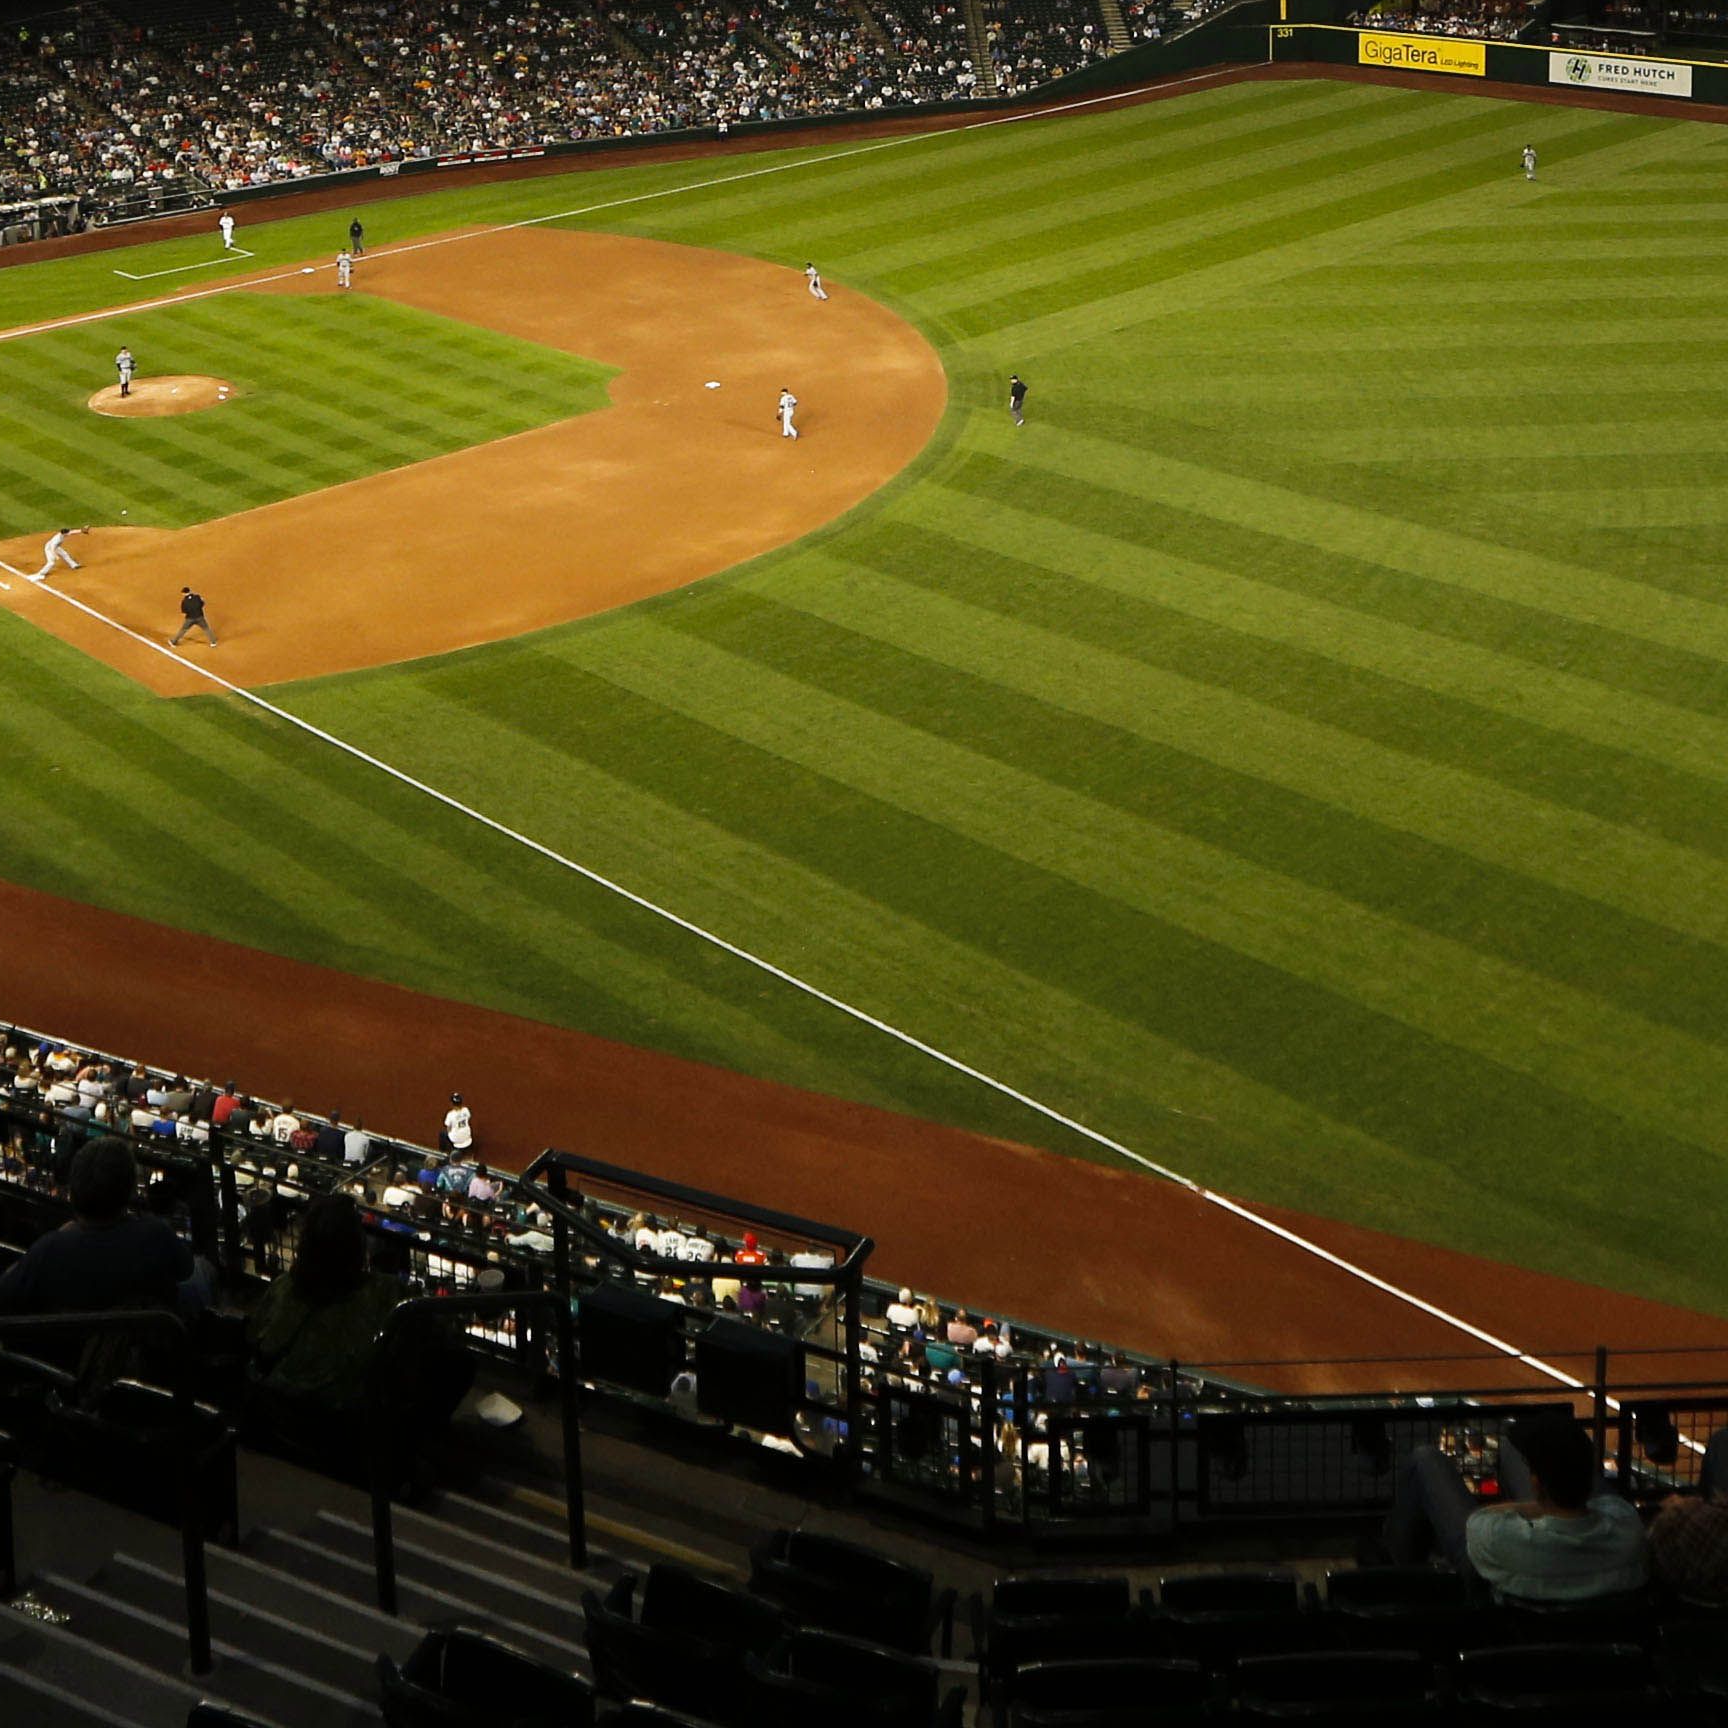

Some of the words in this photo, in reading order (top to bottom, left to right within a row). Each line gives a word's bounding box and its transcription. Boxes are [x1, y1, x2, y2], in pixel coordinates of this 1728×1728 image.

[1277, 28, 1293, 38] 331
[1364, 40, 1438, 65] GigaTera
[1599, 63, 1629, 76] FRED
[1633, 68, 1675, 80] HUTCH
